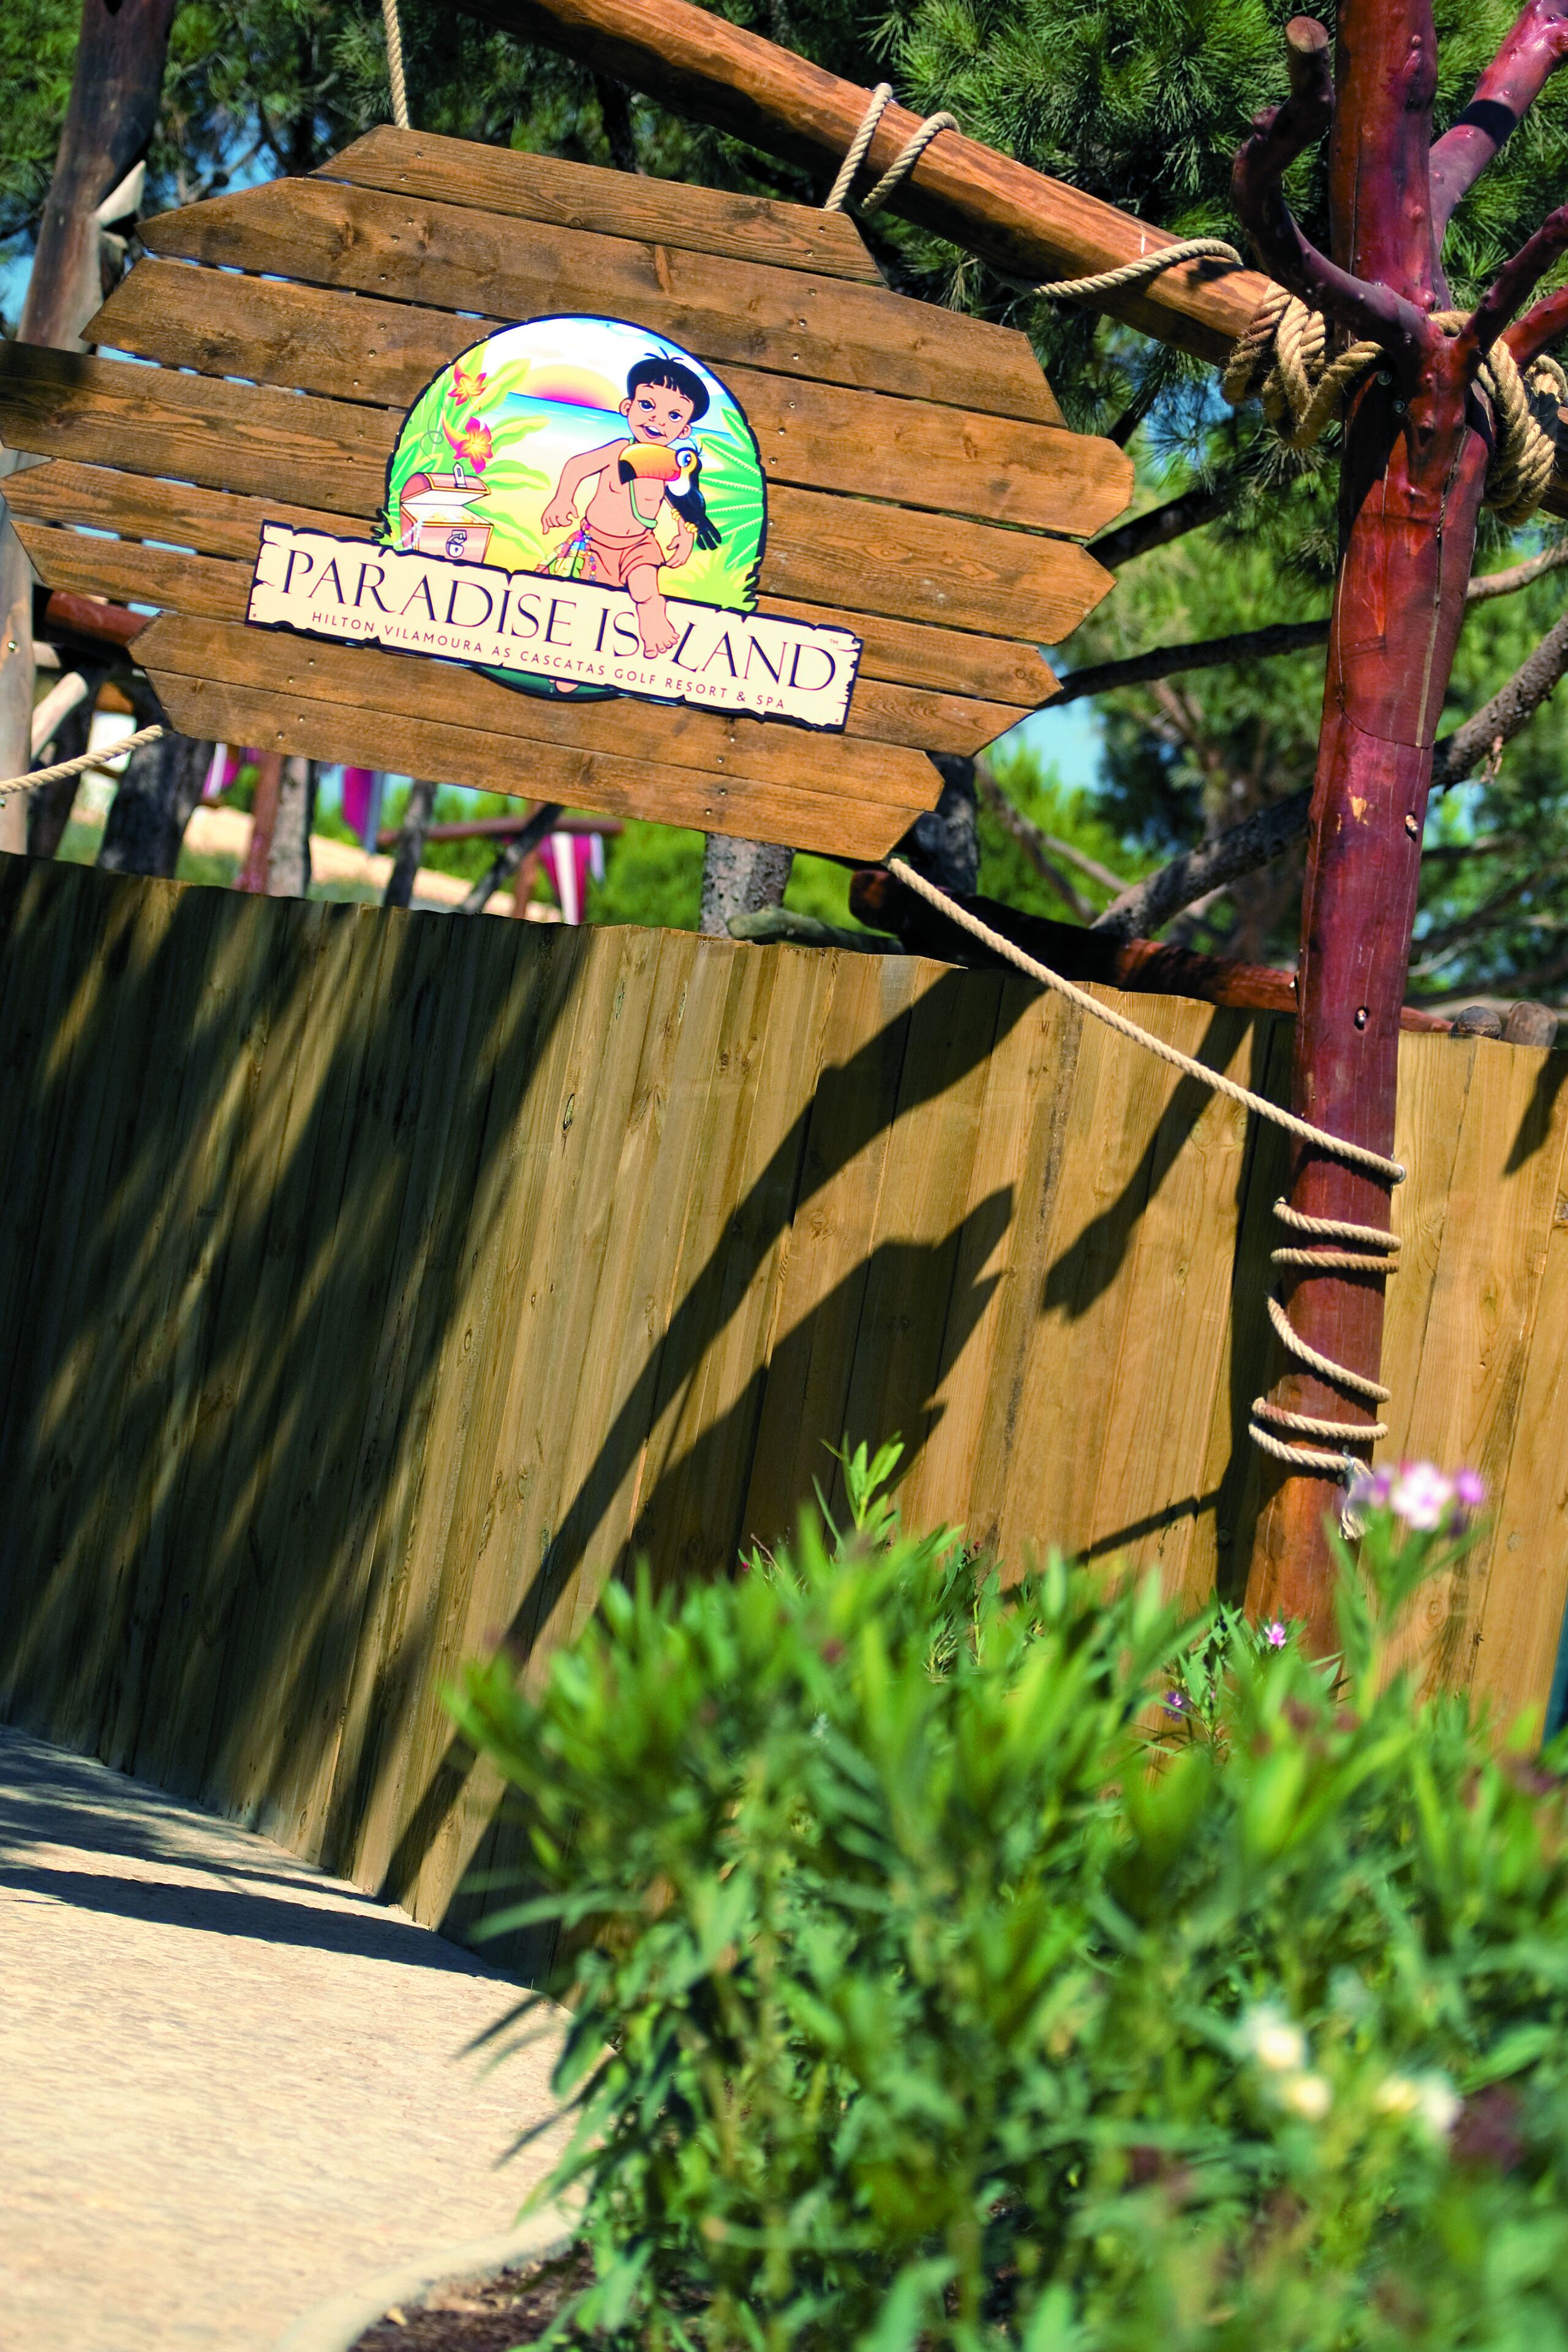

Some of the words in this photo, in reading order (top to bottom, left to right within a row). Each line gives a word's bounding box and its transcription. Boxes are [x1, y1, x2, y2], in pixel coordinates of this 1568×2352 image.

[281, 549, 577, 647] PARADISE
[592, 607, 836, 691] ISLAND
[311, 612, 374, 633] HILTON
[384, 625, 483, 654] VILAMOURA
[491, 646, 511, 658] AS
[520, 650, 605, 676] CASCATAS
[614, 668, 656, 685] GOLF
[665, 677, 728, 698] RESORT
[736, 692, 747, 702] &
[756, 695, 785, 709] SPA
